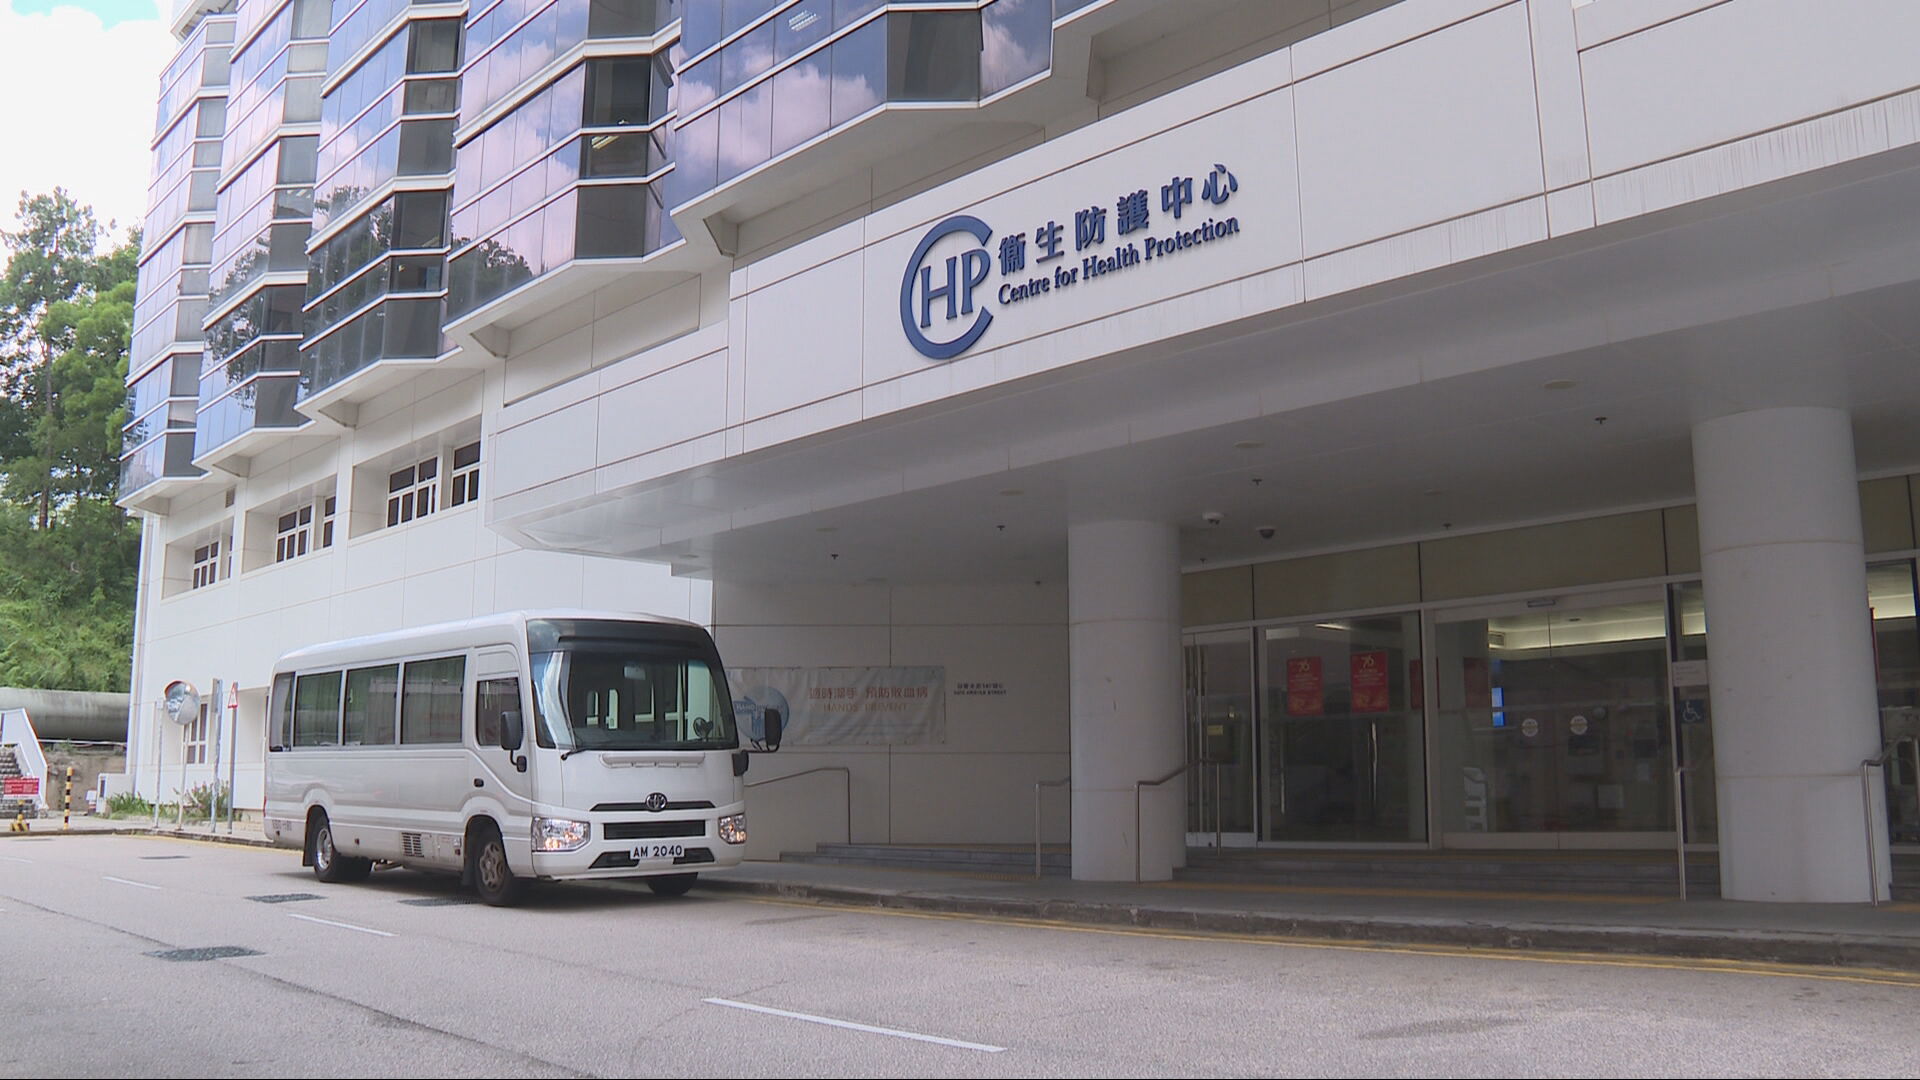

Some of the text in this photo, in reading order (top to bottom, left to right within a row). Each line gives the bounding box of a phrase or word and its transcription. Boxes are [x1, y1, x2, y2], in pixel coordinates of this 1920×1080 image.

[998, 215, 1240, 306] Centre for Health Protection
[633, 845, 683, 857] AM 2040
